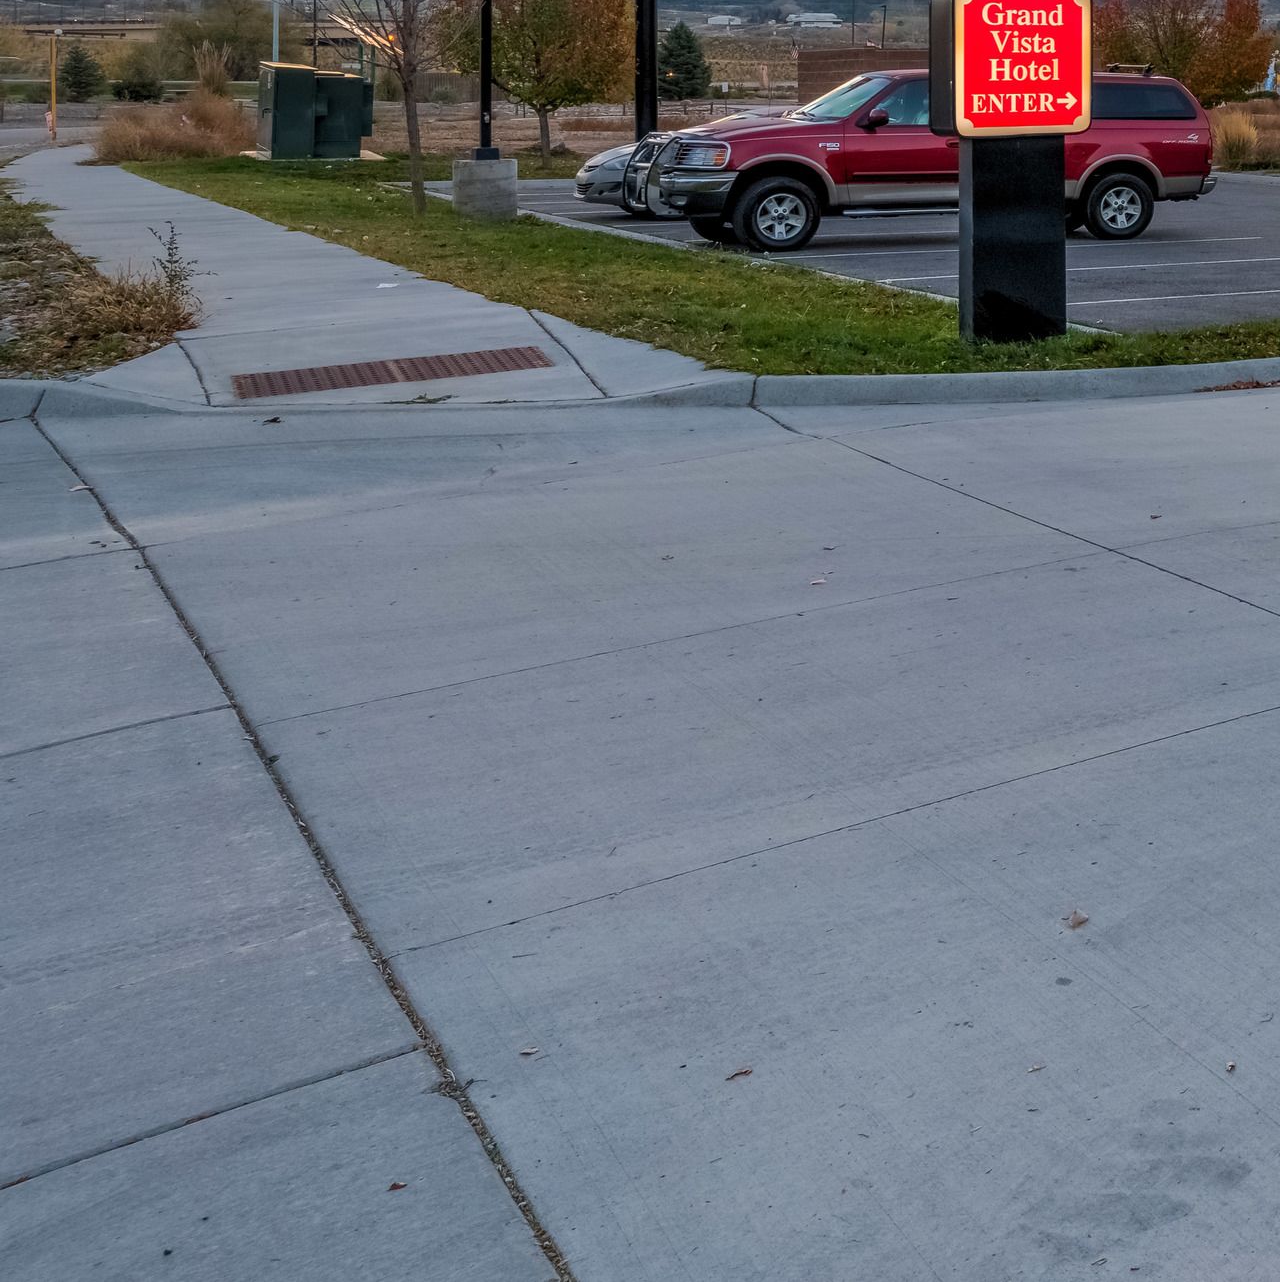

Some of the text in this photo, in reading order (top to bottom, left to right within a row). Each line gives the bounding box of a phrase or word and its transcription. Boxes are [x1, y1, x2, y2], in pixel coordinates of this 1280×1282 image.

[981, 2, 1064, 26] Grand
[990, 30, 1056, 54] Vista
[988, 58, 1060, 81] Hotel
[971, 93, 1055, 114] ENTER
